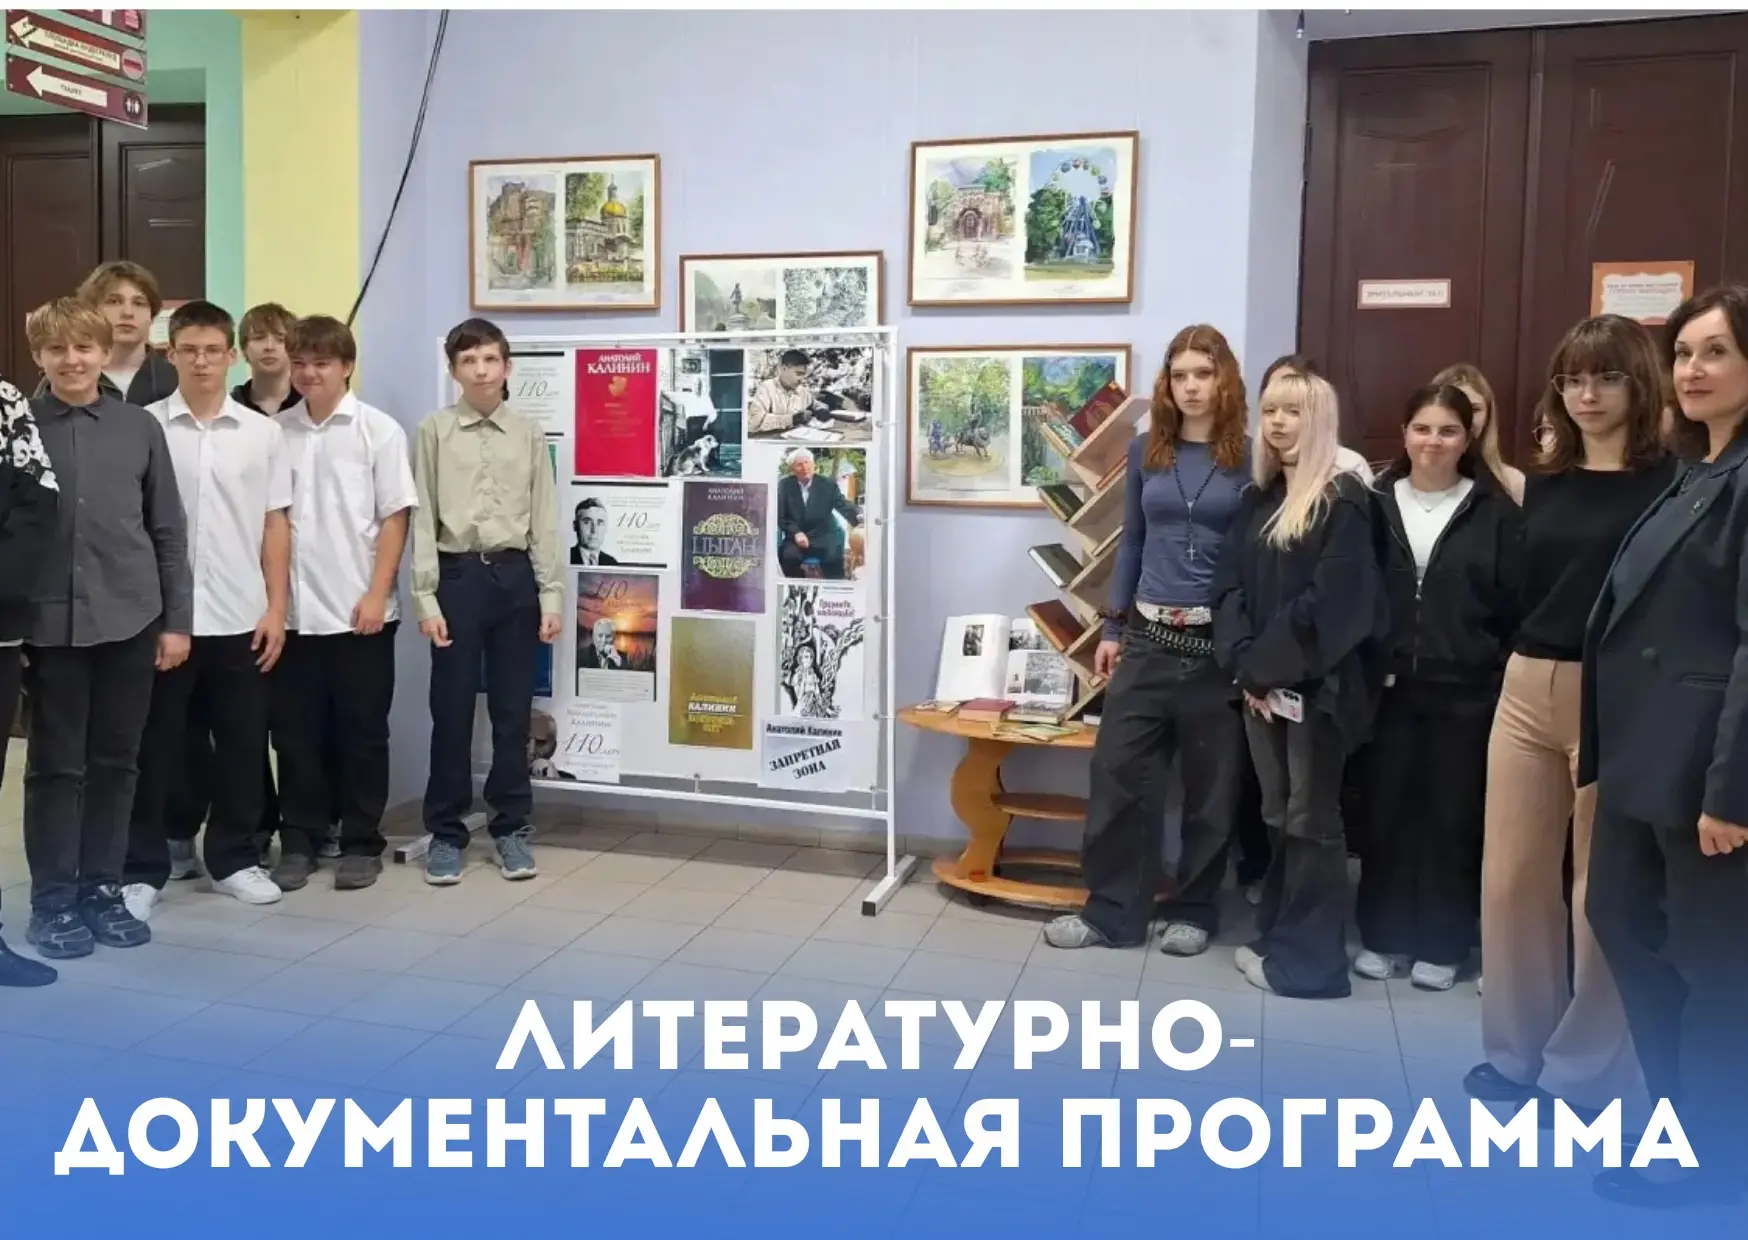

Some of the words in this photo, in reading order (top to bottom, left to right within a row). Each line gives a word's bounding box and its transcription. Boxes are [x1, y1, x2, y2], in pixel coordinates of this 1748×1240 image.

[598, 352, 642, 363] АНАТОЛИЙ
[587, 362, 651, 374] КАЛИНИН
[516, 379, 548, 398] 110
[616, 511, 648, 529] 110
[688, 702, 737, 713] КАЛИНИН
[766, 723, 806, 735] Анатолий
[807, 726, 843, 737] Калинин
[562, 732, 604, 755] 110
[769, 738, 842, 772] ЗАПРЕТНАЯ
[792, 760, 827, 780] ЗОНА
